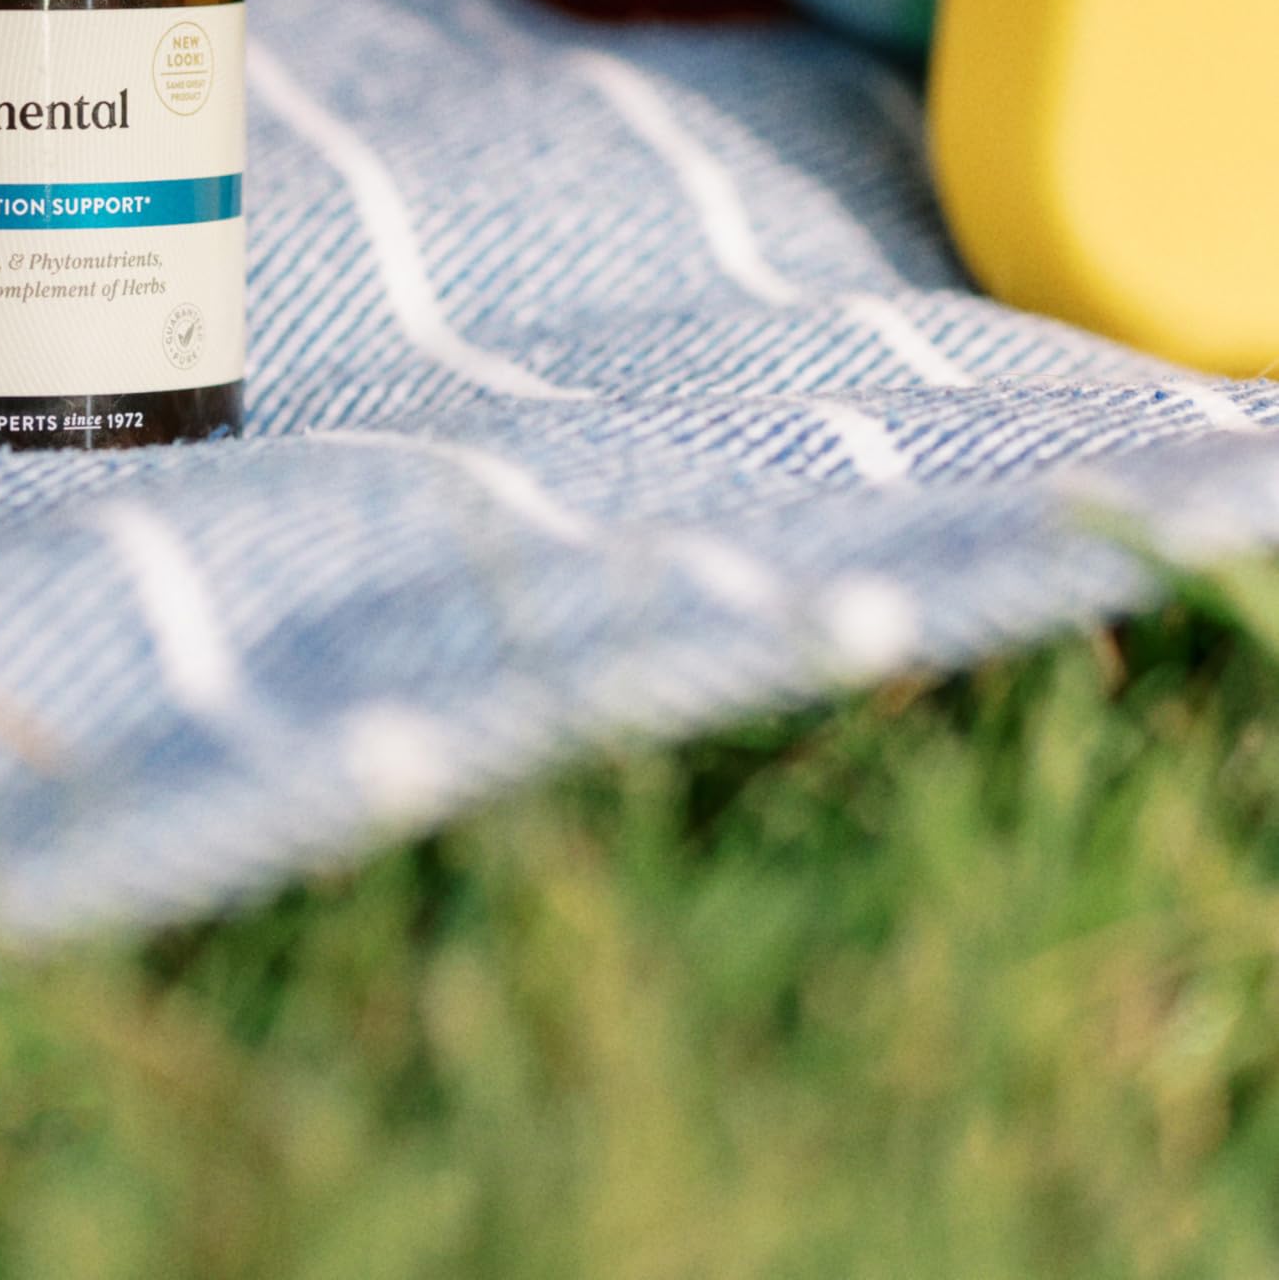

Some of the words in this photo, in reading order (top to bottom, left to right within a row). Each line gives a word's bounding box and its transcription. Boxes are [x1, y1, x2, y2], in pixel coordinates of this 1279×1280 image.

[172, 36, 200, 49] NEW
[8, 253, 24, 270] &
[29, 250, 163, 274] Phytonutrients,
[101, 278, 121, 302] of
[121, 276, 166, 295] Herbs
[63, 414, 102, 430] since
[106, 412, 144, 428] 1972
